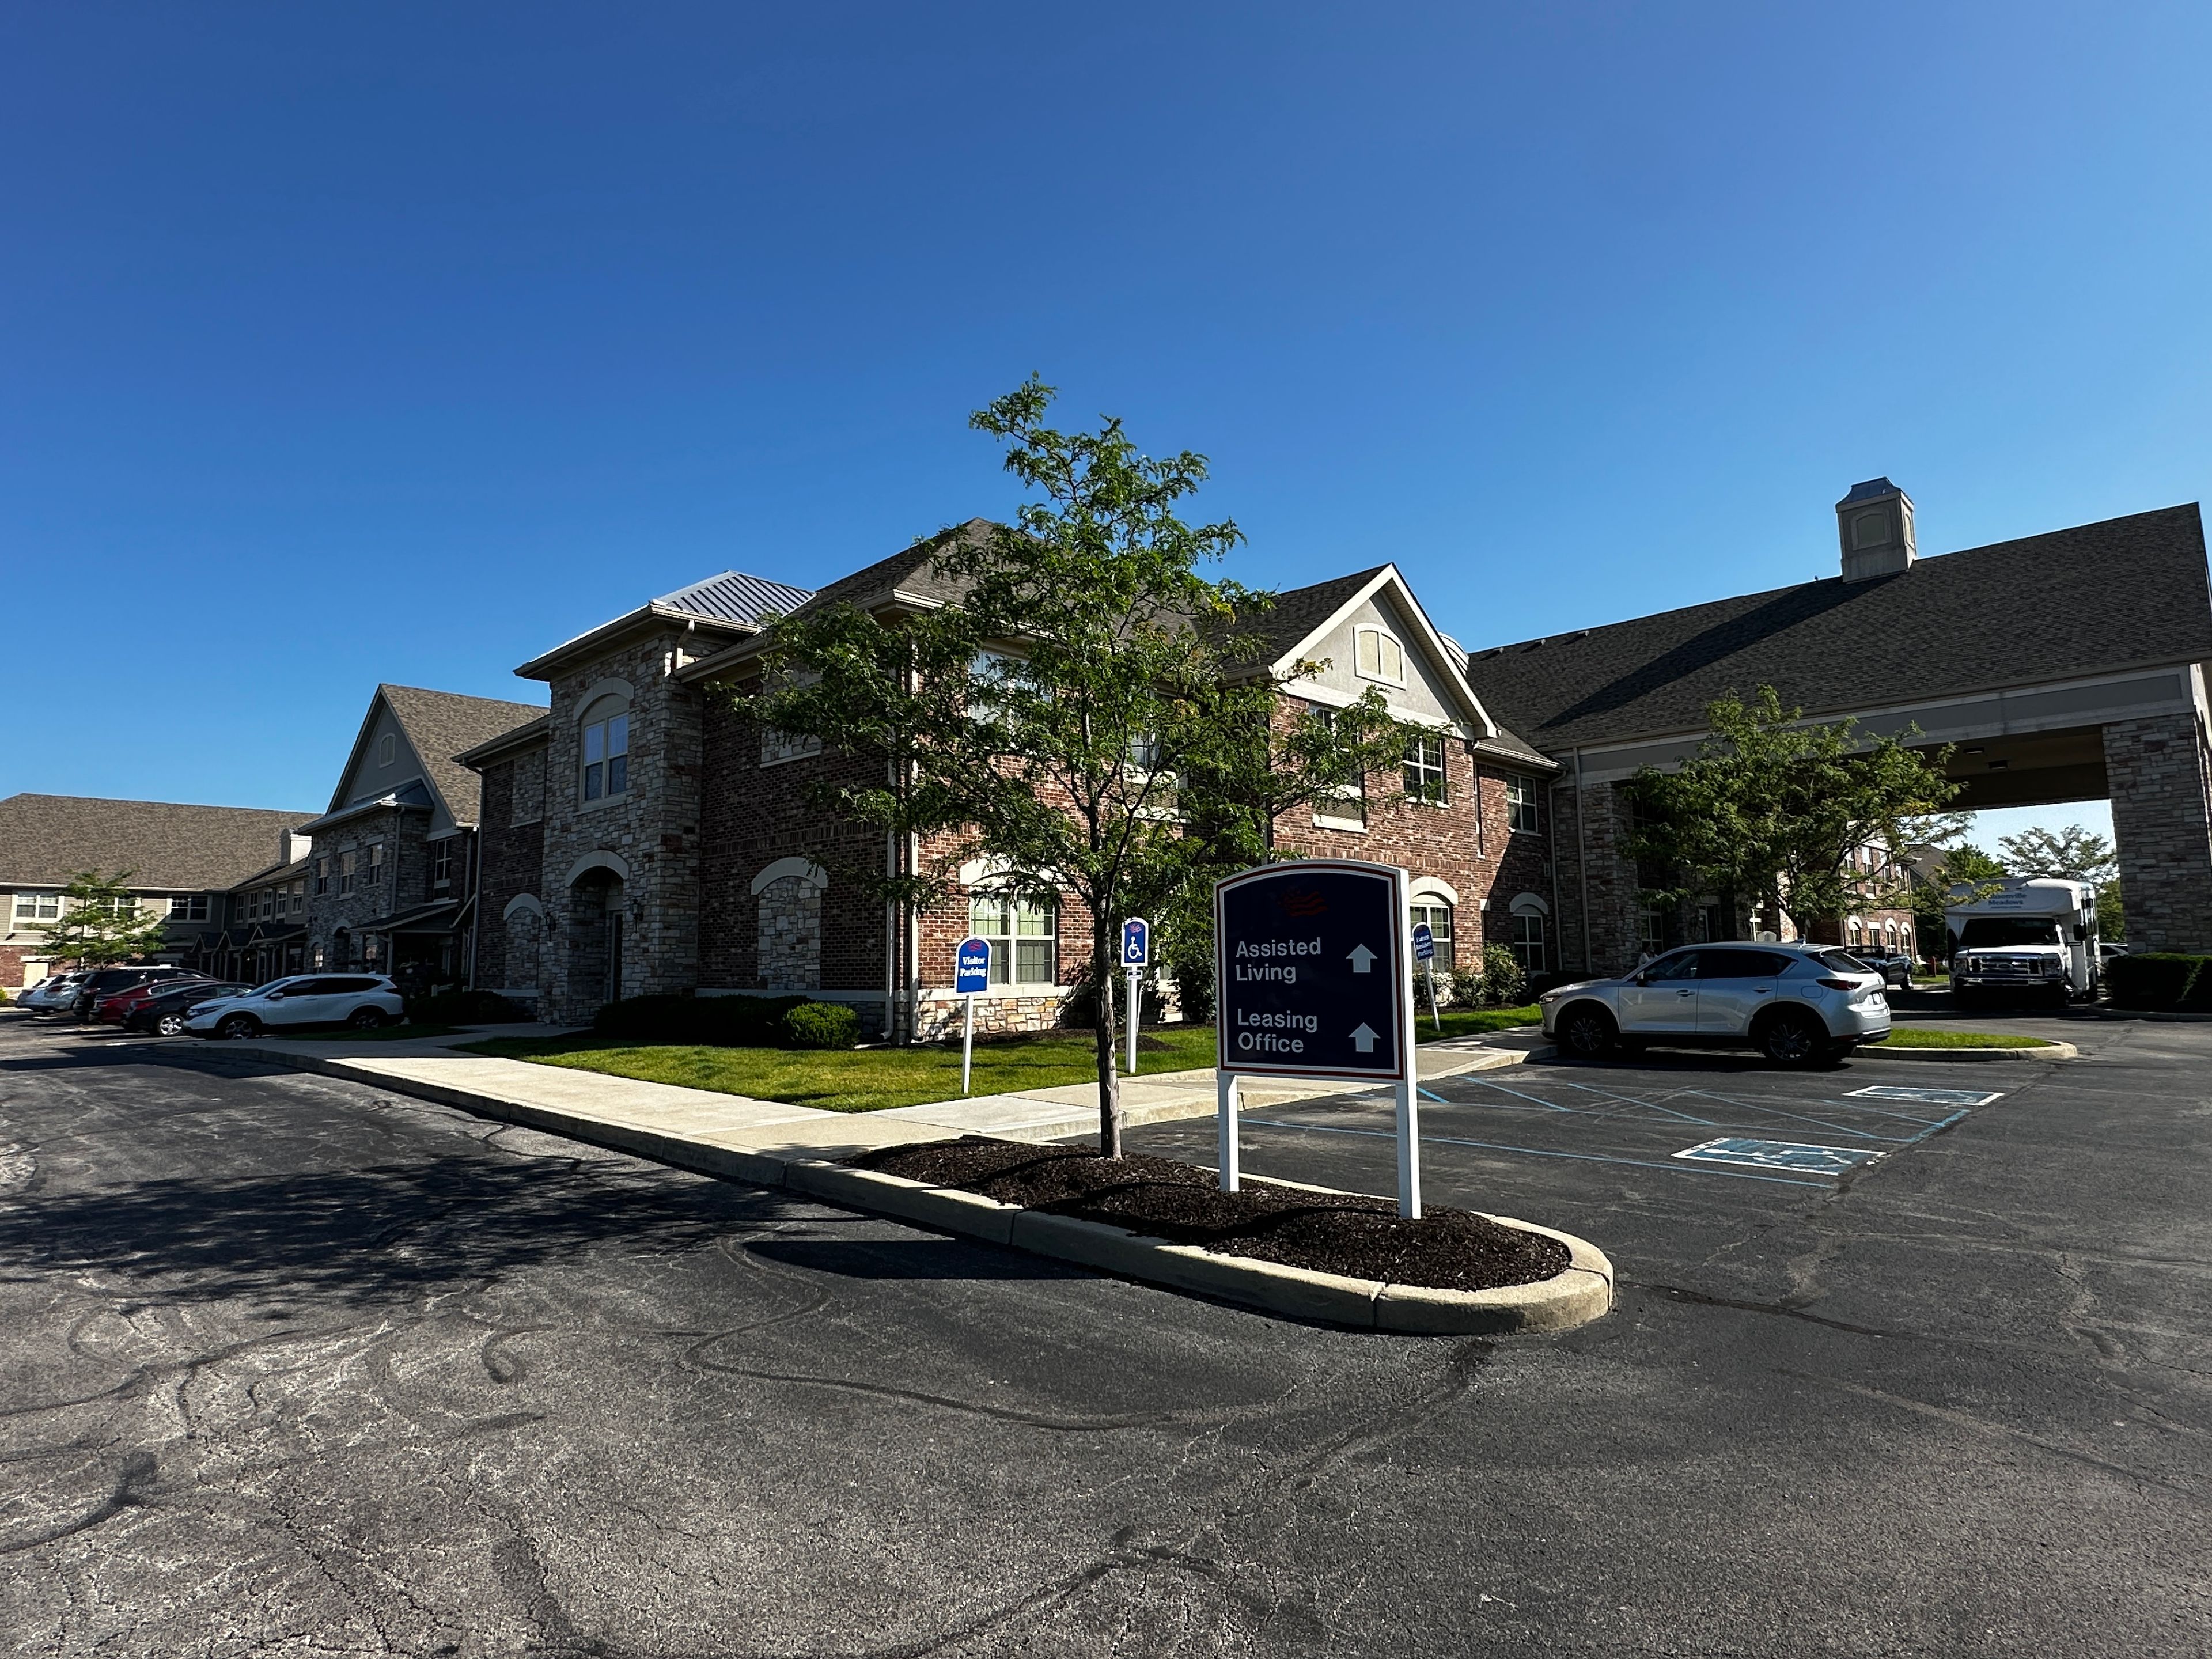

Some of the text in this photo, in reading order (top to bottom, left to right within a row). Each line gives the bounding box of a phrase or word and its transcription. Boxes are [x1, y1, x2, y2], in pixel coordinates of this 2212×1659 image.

[1236, 937, 1321, 958] Assisted
[962, 956, 986, 965] Visitor
[959, 967, 987, 978] Parking
[1236, 963, 1296, 984] Living
[1238, 1008, 1318, 1033] Leasing
[1238, 1032, 1304, 1053] Office
